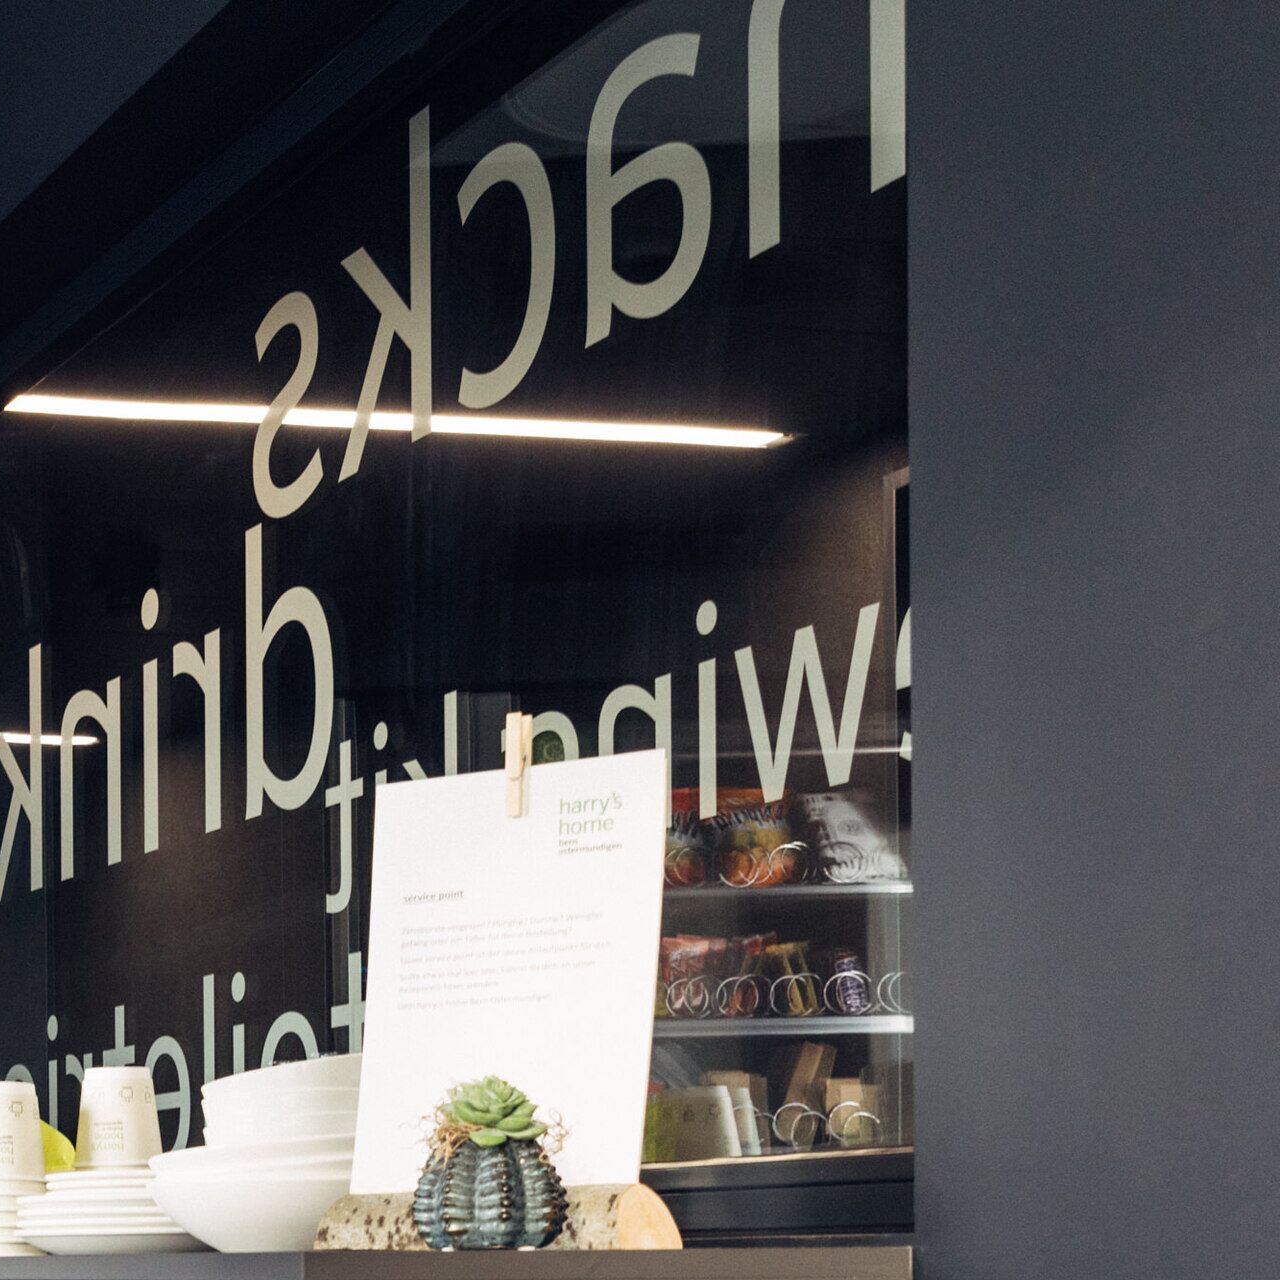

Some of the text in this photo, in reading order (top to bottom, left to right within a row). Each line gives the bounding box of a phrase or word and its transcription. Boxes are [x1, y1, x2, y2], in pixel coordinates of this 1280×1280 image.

[560, 791, 623, 816] harry's
[559, 818, 615, 835] home
[438, 889, 464, 901] point
